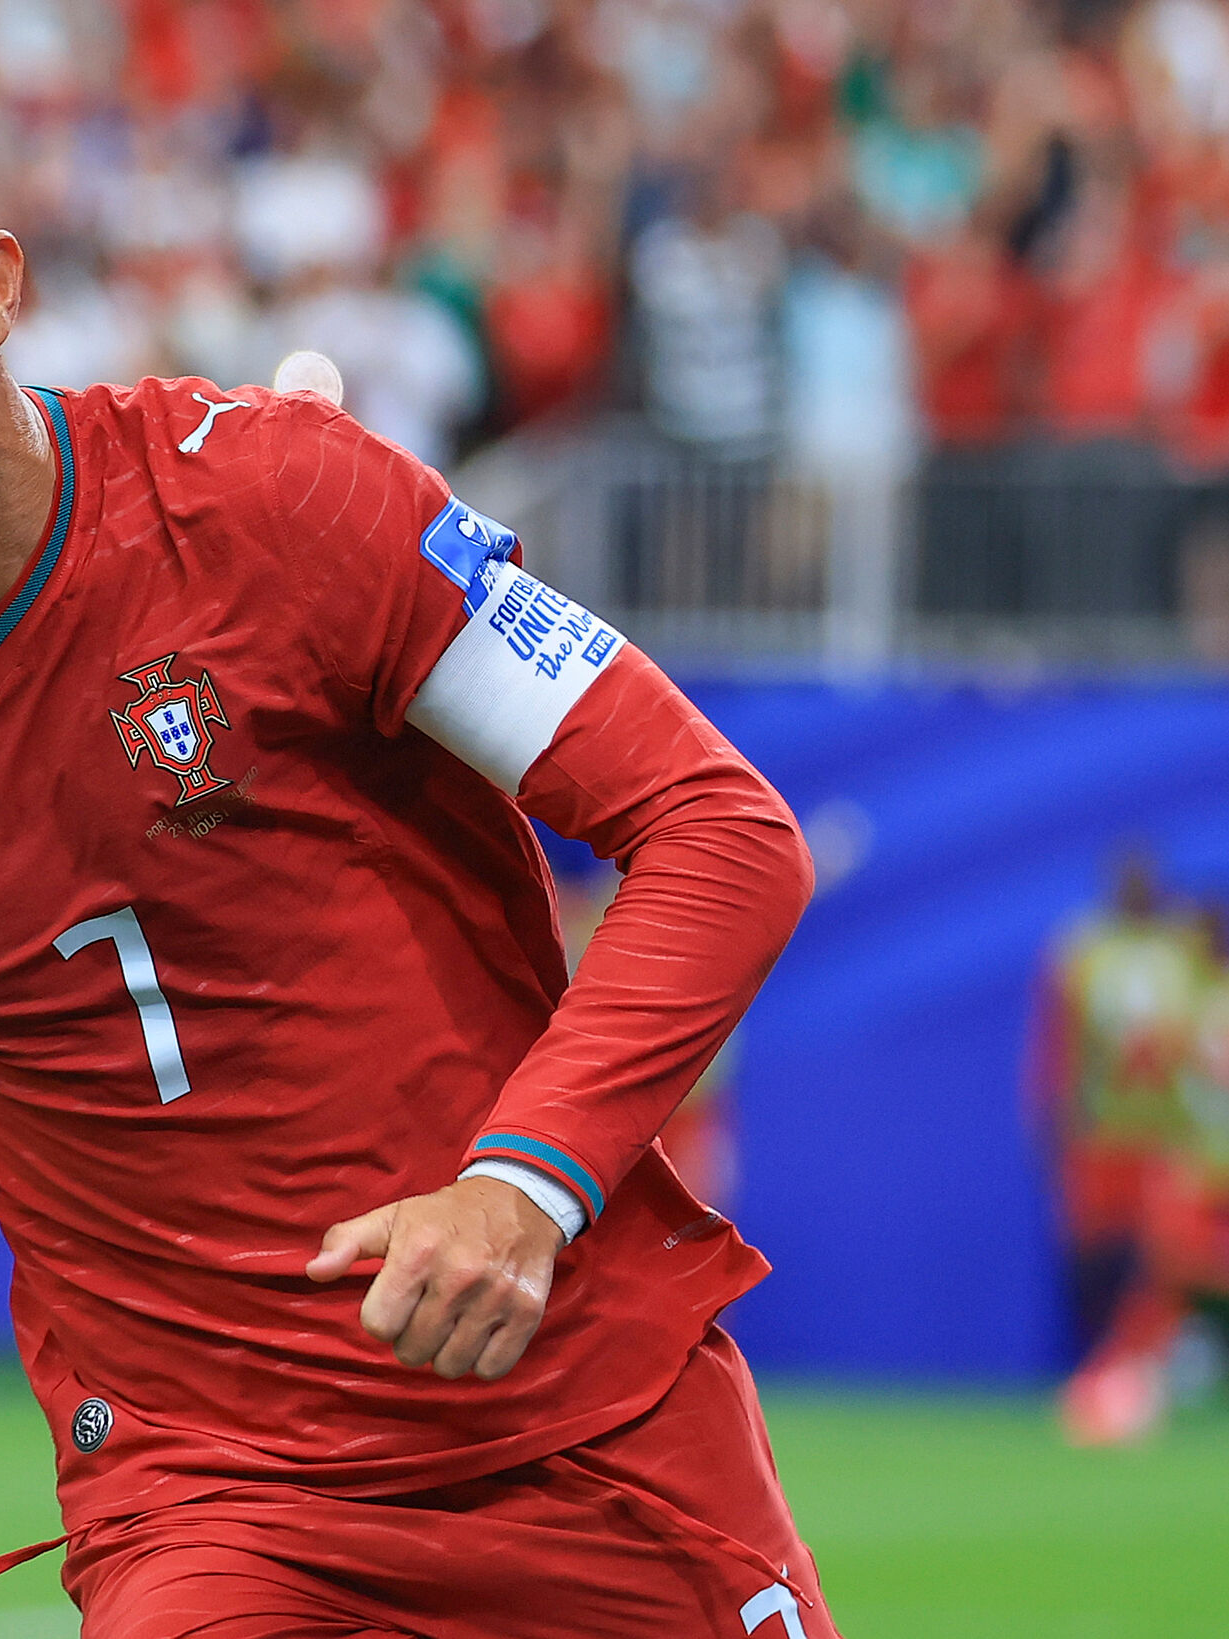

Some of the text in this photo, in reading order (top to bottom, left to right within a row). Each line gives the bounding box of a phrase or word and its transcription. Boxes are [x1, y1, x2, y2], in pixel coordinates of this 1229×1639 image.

[489, 575, 539, 635] FOOTBA
[507, 587, 569, 661] UNITE
[535, 640, 572, 680] the
[585, 631, 617, 665] FIFA
[145, 816, 171, 840] PORT
[168, 823, 184, 838] 23
[52, 906, 192, 1105] 7
